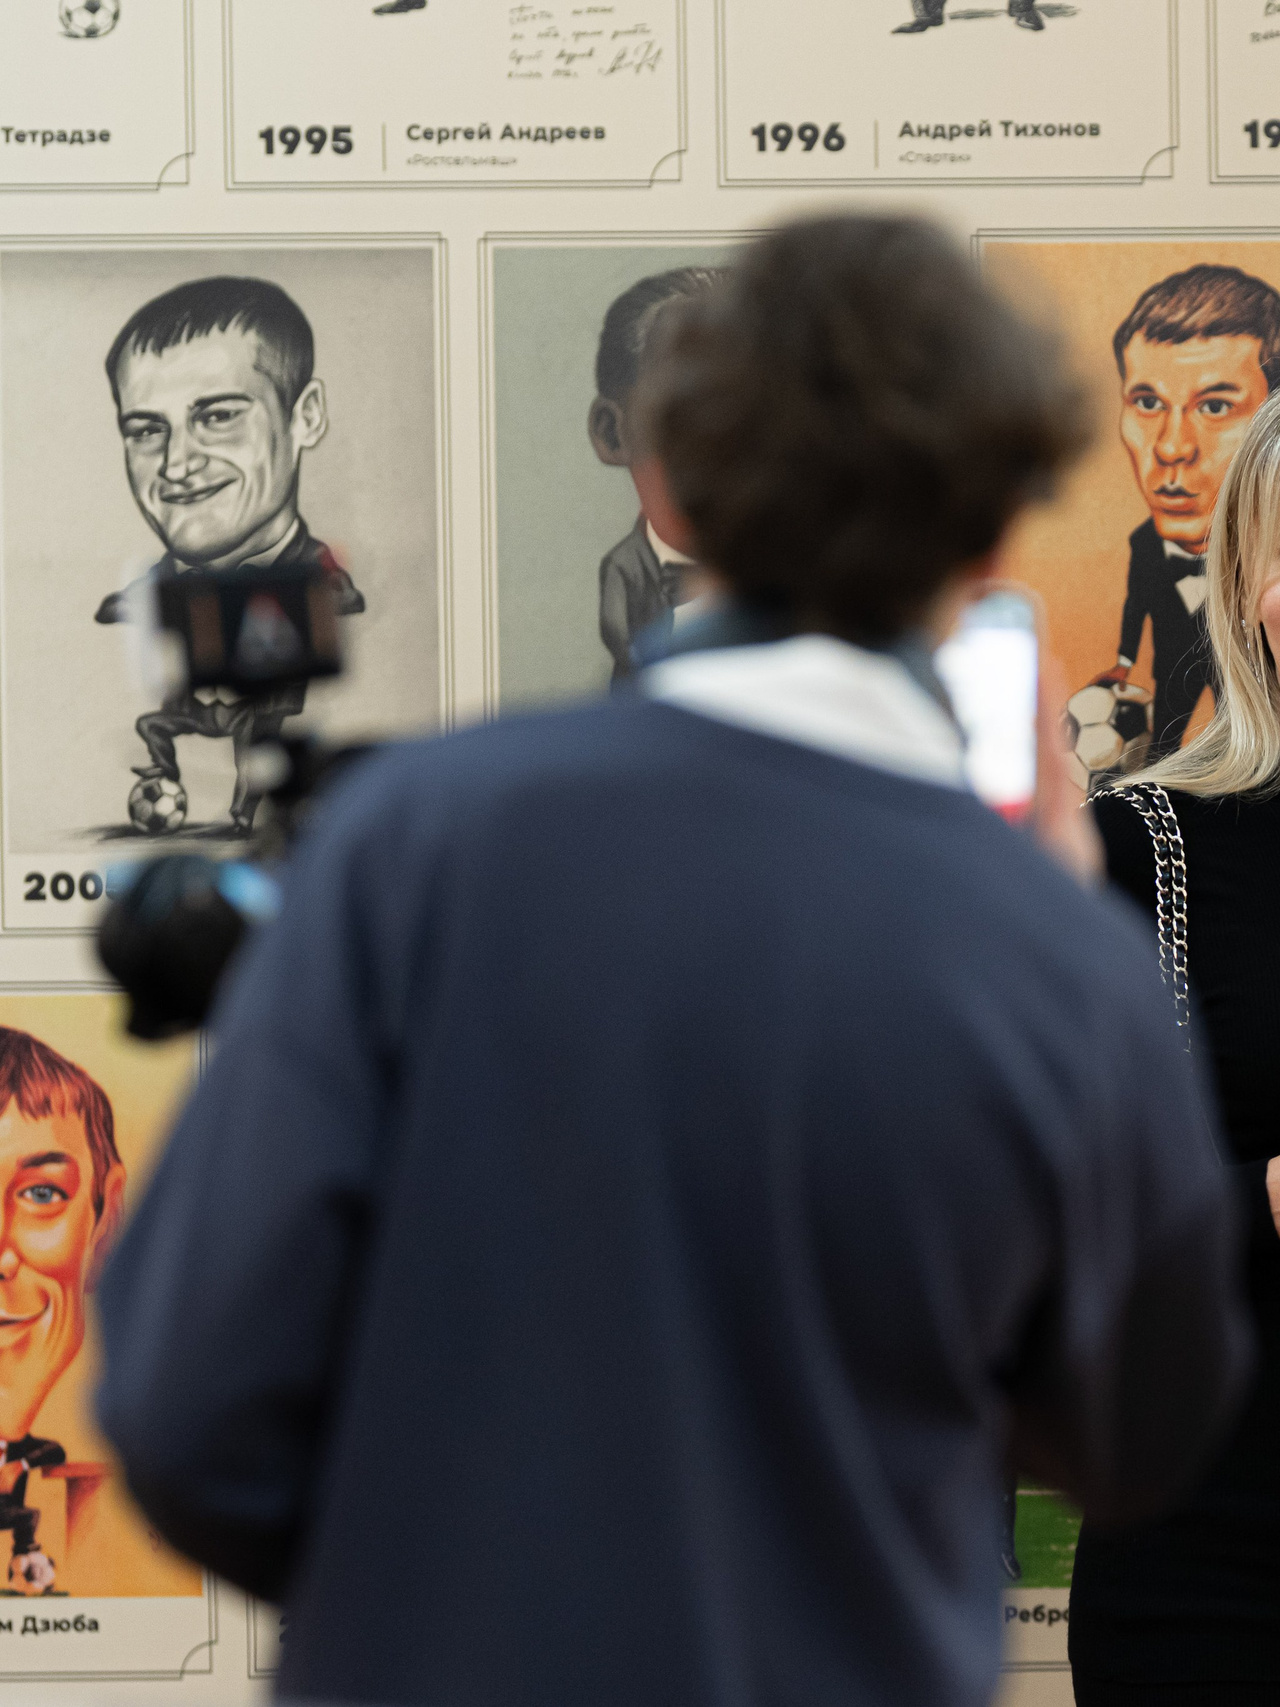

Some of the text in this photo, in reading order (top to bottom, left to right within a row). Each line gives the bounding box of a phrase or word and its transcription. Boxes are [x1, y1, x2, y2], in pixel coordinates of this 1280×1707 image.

[1, 126, 112, 149] Тетрадзе
[258, 125, 355, 156] 1995
[405, 122, 606, 146] Сергей Андреев
[750, 122, 848, 153] 1996
[898, 120, 1101, 142] Андрей Тихонов
[24, 871, 116, 901] 200
[20, 1613, 100, 1635] Дзюба
